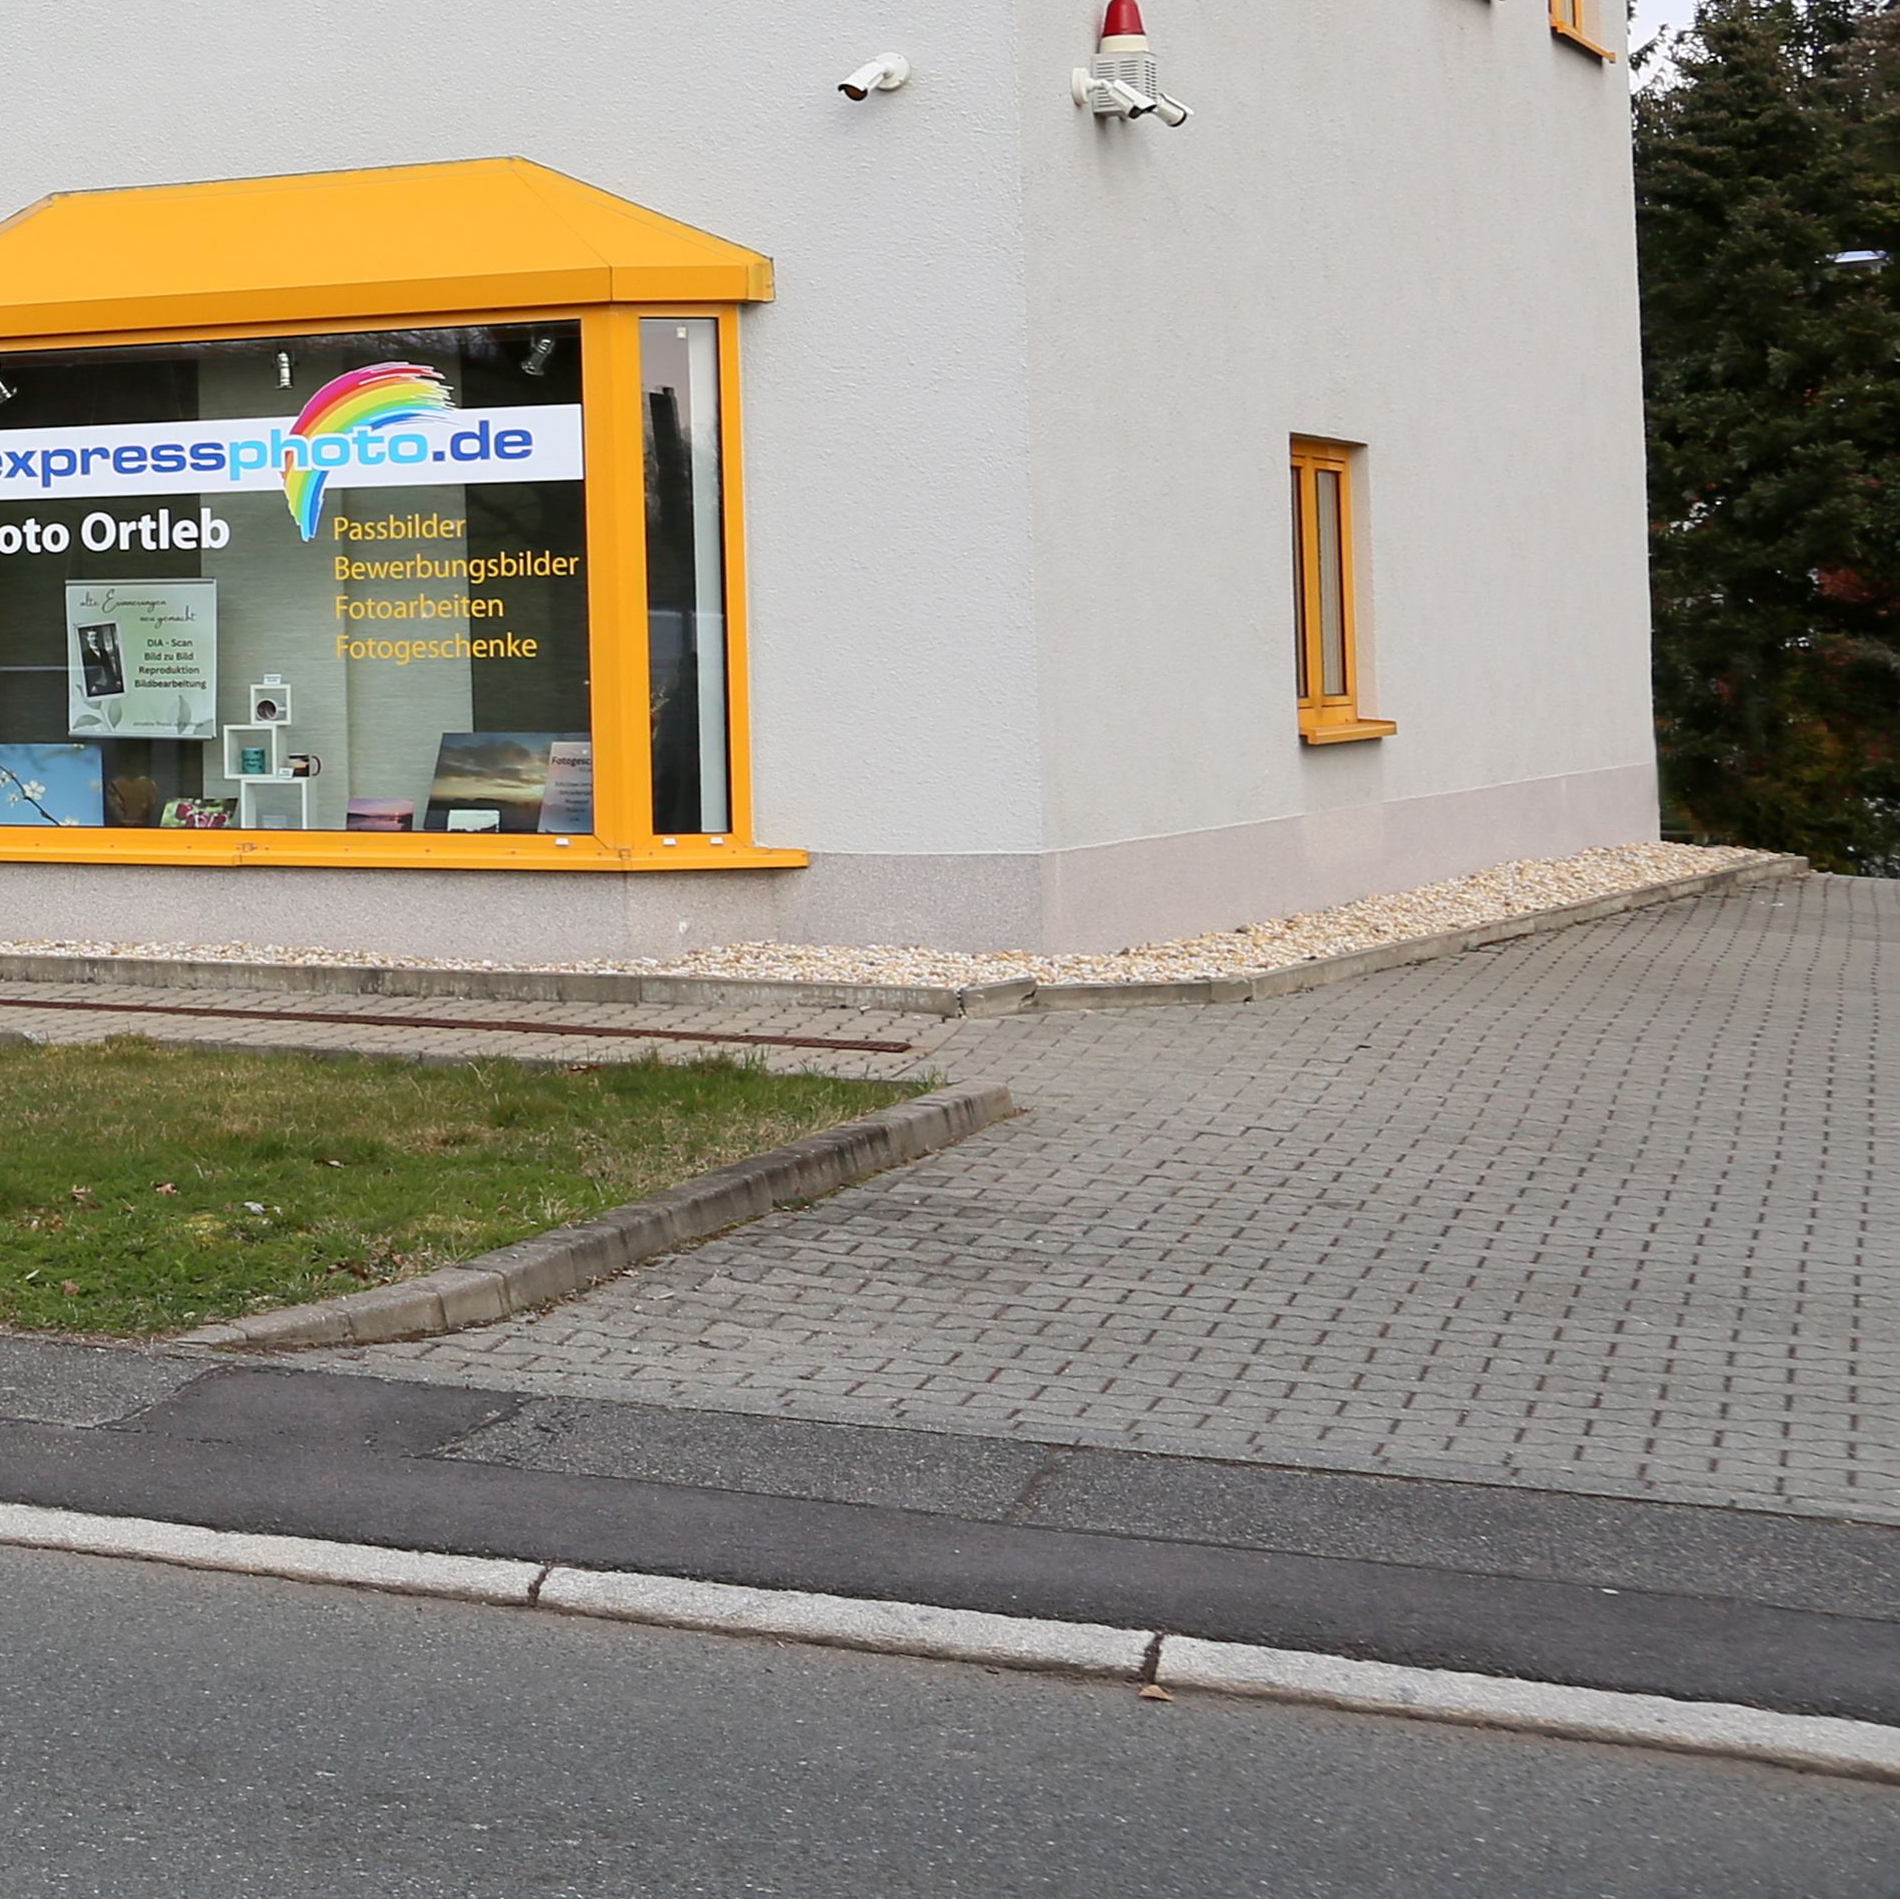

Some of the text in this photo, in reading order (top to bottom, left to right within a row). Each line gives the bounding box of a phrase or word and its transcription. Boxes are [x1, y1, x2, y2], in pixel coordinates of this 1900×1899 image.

[81, 508, 232, 551] Ortleb
[333, 513, 467, 540] Passbilder
[334, 550, 580, 584] Bewerbungsbilder
[334, 593, 504, 620] Fotoarbeiten
[144, 652, 161, 661] Bild
[176, 652, 194, 661] Bild
[147, 639, 163, 647] DIA
[171, 638, 193, 648] Scan
[335, 631, 538, 665] Fotogeschenke
[138, 665, 200, 676] Reproduktion
[134, 679, 207, 690] Bildbearbeitung
